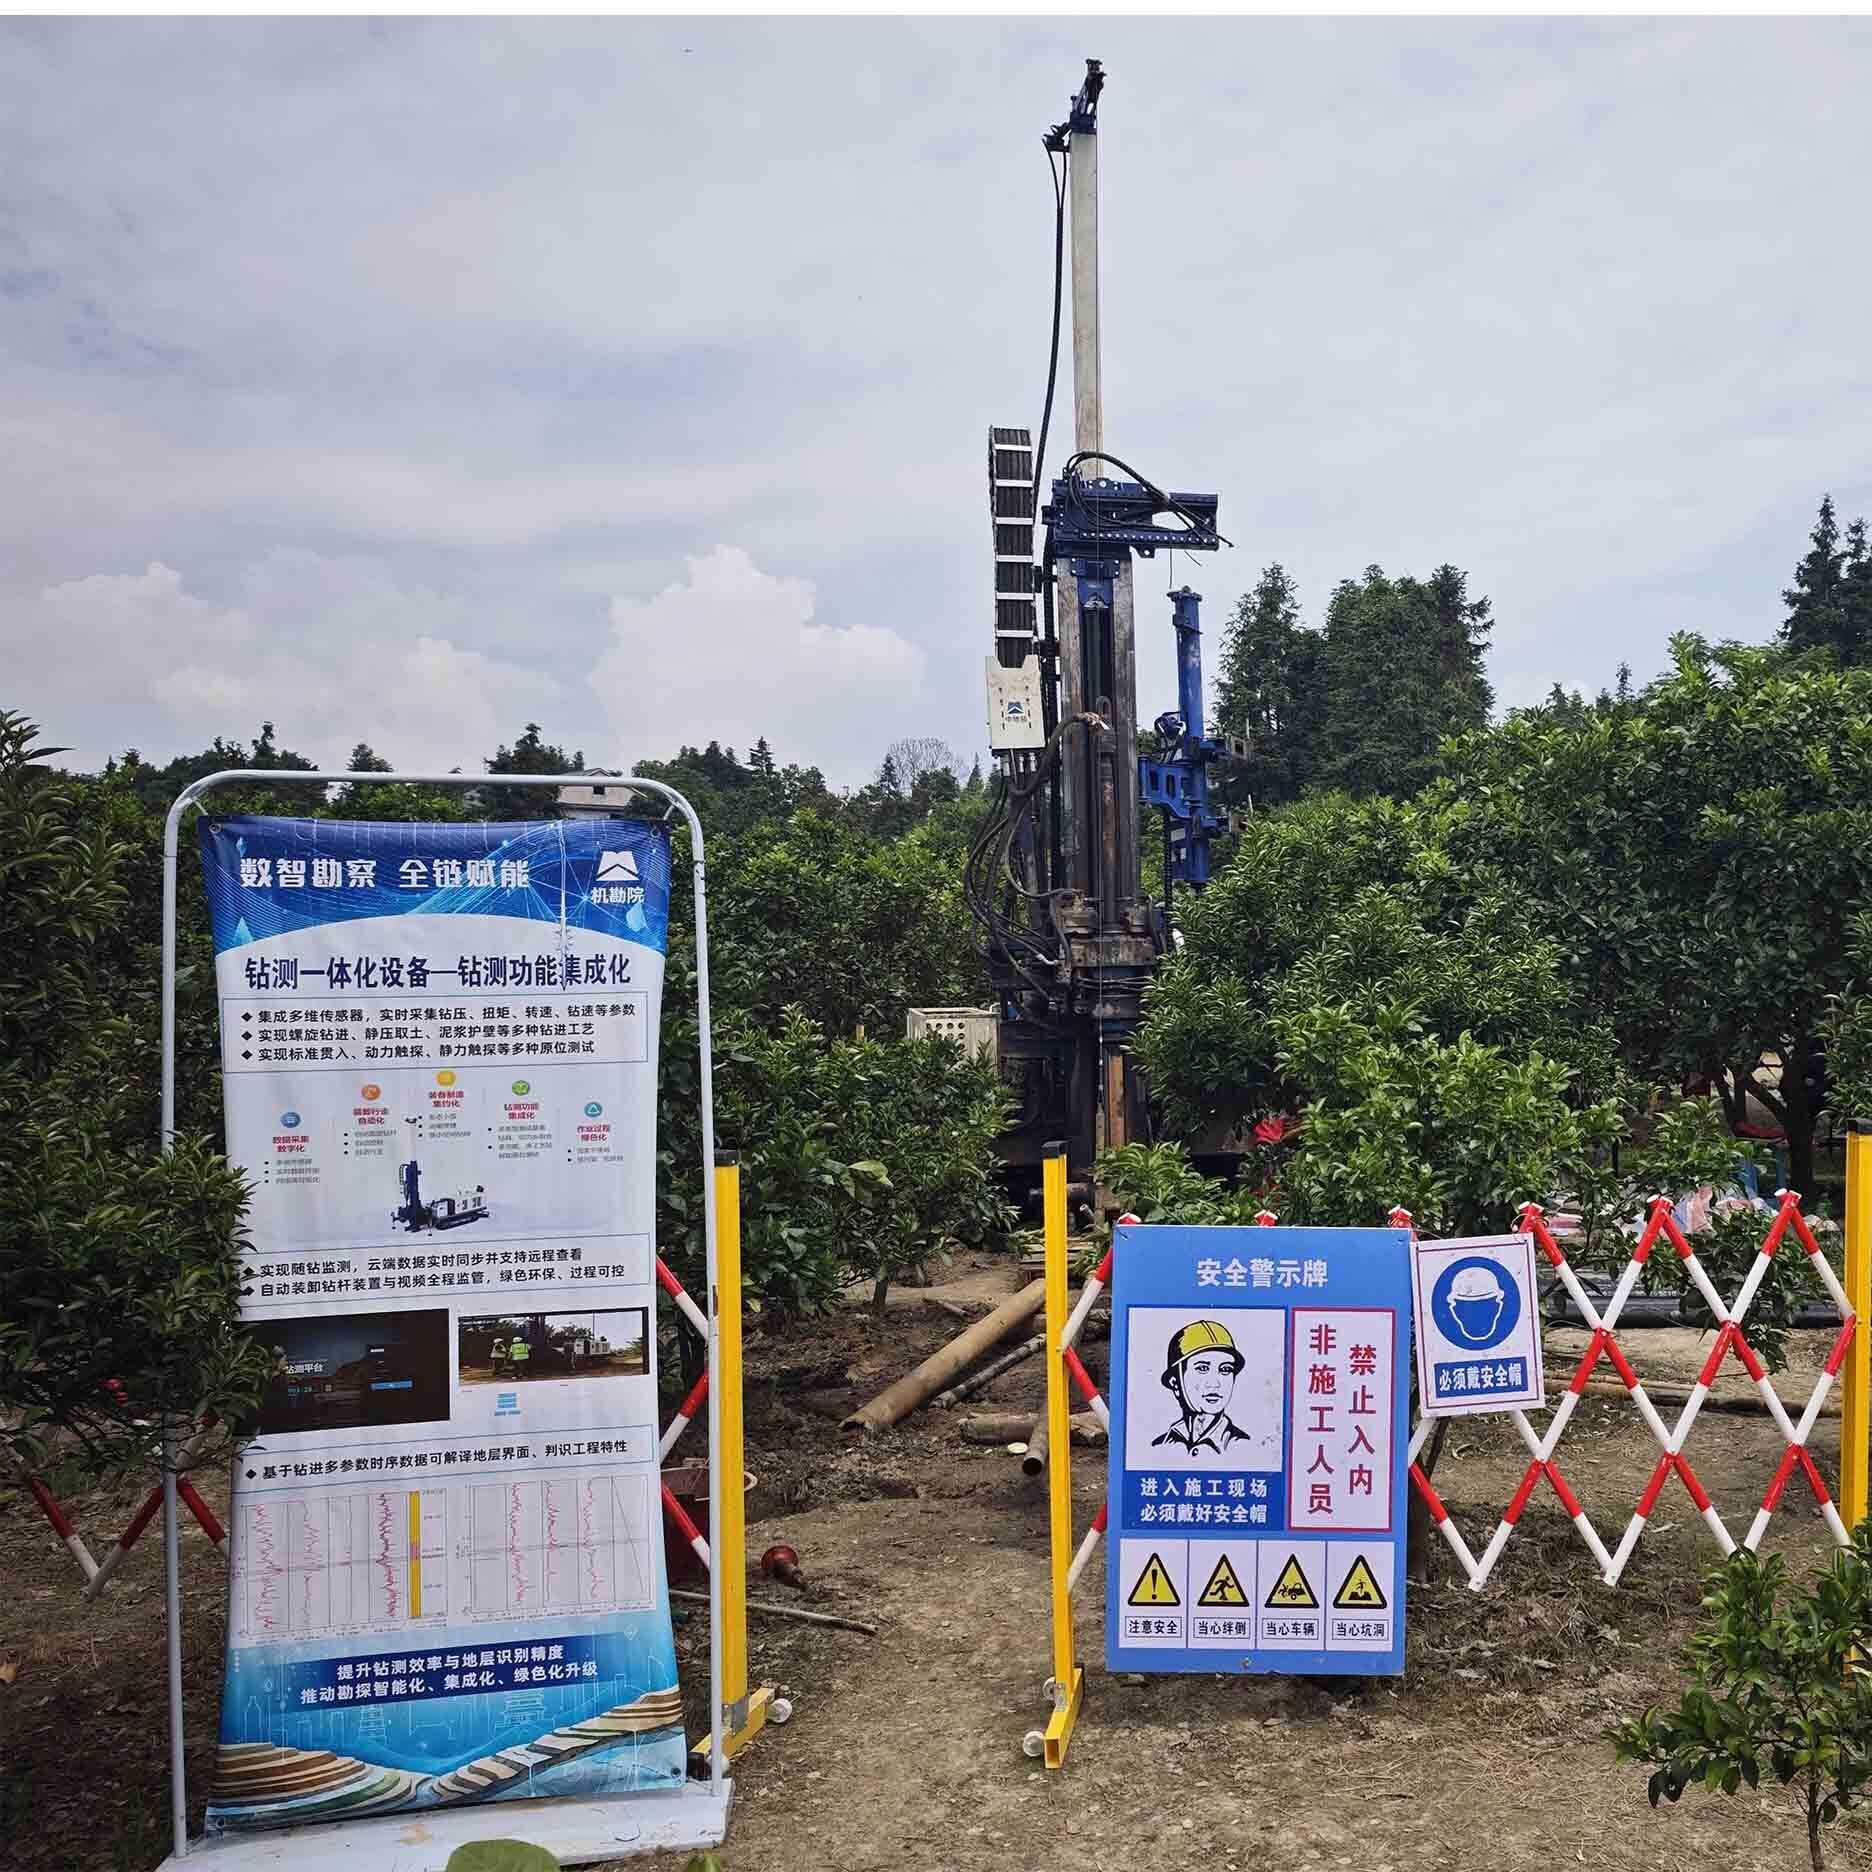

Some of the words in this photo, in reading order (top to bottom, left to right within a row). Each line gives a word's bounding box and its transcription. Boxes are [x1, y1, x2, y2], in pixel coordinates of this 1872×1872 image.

[239, 857, 378, 889] 数智勘察
[399, 857, 531, 889] 全链赋能
[590, 885, 645, 904] 机勘院
[1196, 1257, 1330, 1290] 安全警示牌
[1438, 1361, 1523, 1392] 必须戴安全帽
[1307, 1322, 1338, 1516] 非施工人员
[1347, 1343, 1378, 1497] 禁止入内
[1139, 1477, 1269, 1499] 进入施工现场
[1139, 1503, 1268, 1525] 必须戴好安全帽
[1128, 1618, 1179, 1636] 注意安全
[1264, 1619, 1316, 1637] 当心车辆
[1335, 1621, 1386, 1638] 当心坑洞
[336, 1643, 565, 1681] 提升钻测效率与地层识别精度
[299, 1660, 599, 1706] 推动勘探智能化、集成化、绿色化升级
